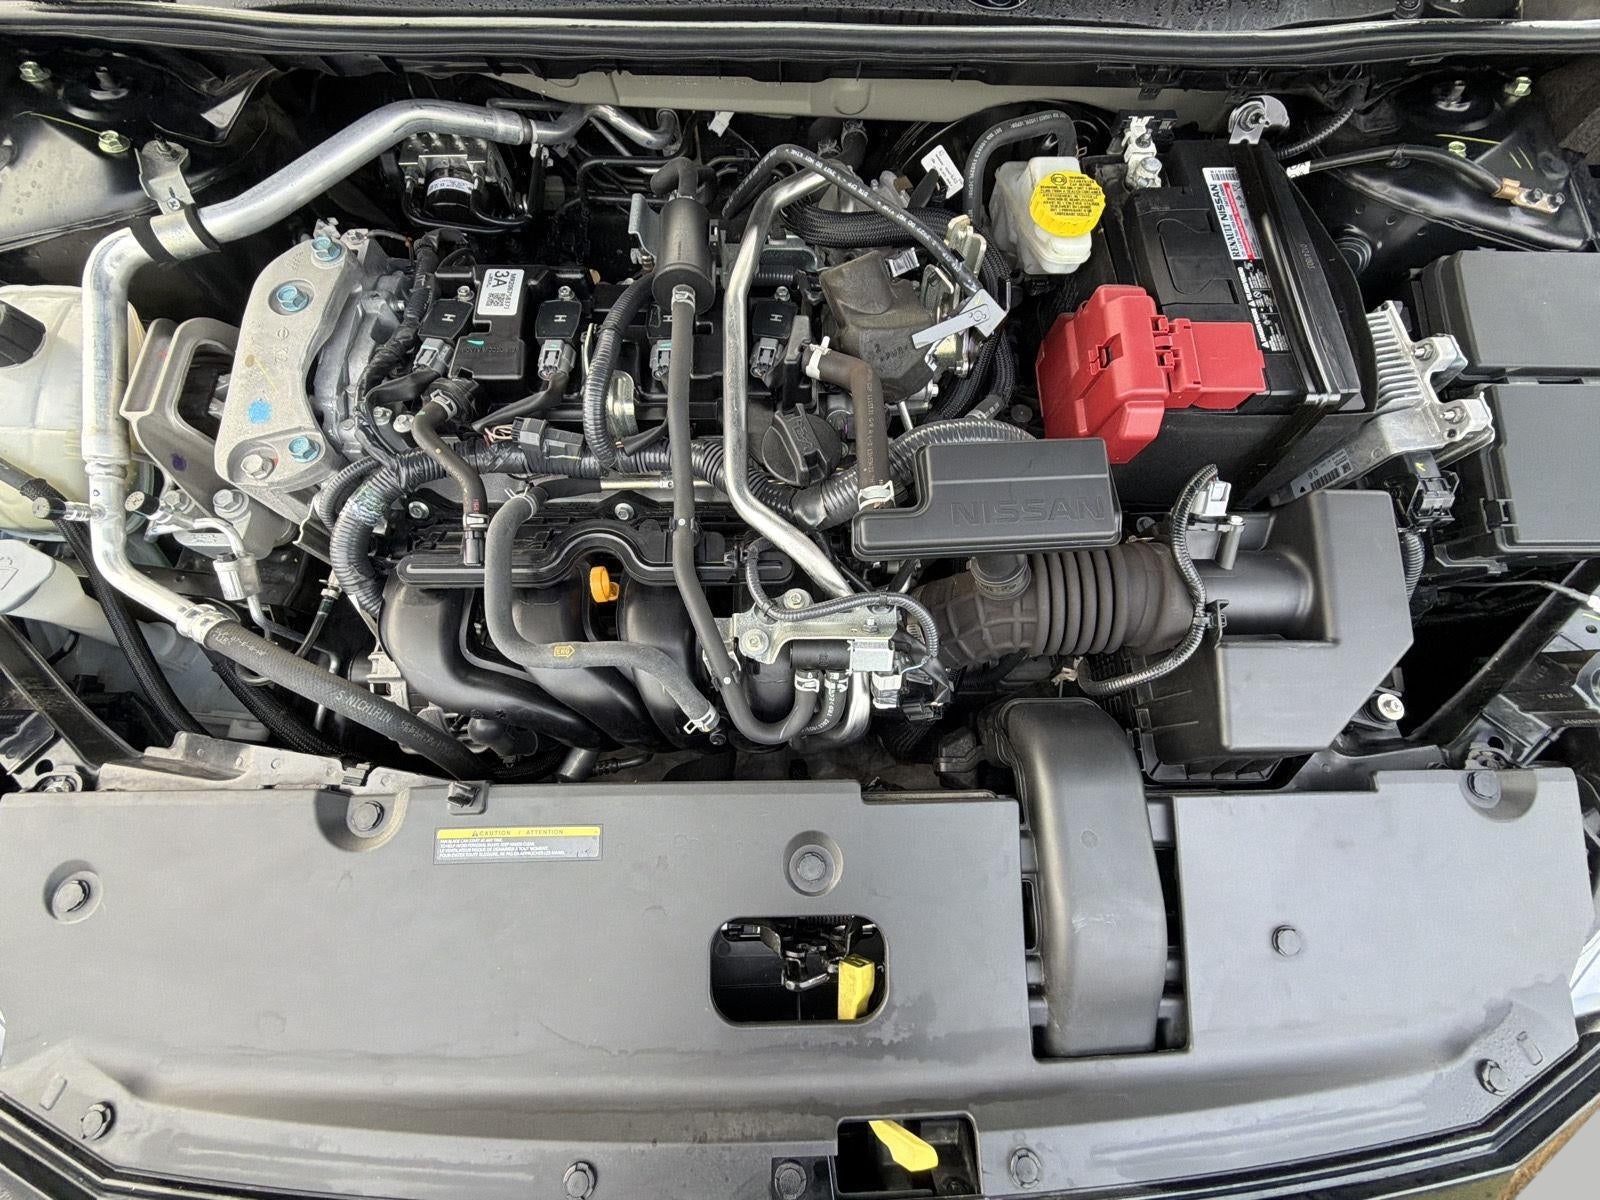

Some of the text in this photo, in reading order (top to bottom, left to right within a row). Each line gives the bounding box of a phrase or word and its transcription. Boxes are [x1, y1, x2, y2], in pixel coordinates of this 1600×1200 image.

[1210, 183, 1229, 221] NISSAN
[1223, 222, 1241, 258] RENAULT
[492, 271, 510, 288] 3A
[950, 496, 1105, 527] NISSAN
[336, 690, 394, 723] S-NICHIRIN
